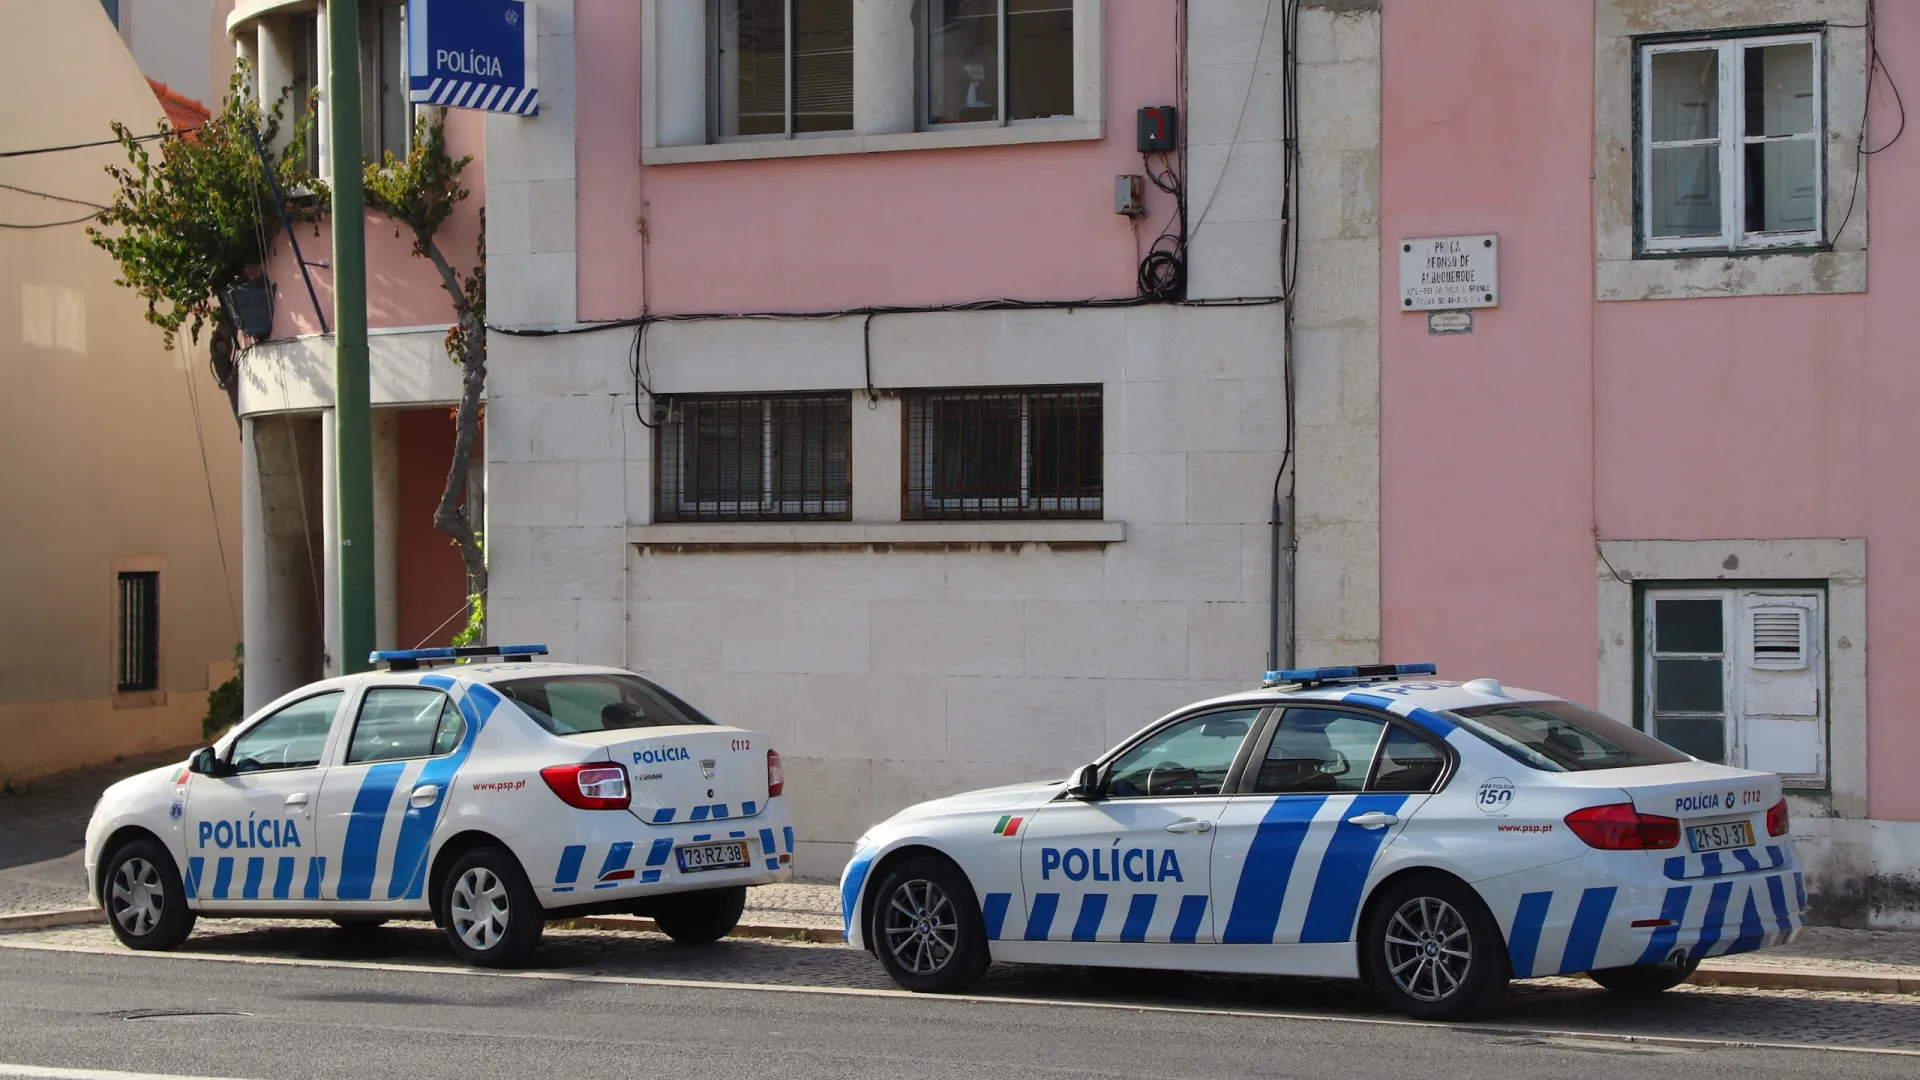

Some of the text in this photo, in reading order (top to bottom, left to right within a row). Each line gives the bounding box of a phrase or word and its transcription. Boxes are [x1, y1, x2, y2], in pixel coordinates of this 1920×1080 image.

[436, 48, 503, 77] POLÍCIA
[1426, 256, 1457, 269] AFONSO
[1421, 270, 1475, 284] ALBUQUERQUE
[735, 740, 750, 750] 112
[633, 745, 690, 764] POLÍCIA
[473, 779, 526, 792] www.psp.pt
[1479, 789, 1512, 804] 150
[1676, 792, 1720, 812] POLÍCIA
[1747, 790, 1761, 804] 112
[199, 811, 301, 849] POLÍCIA
[1497, 824, 1552, 833] www.psp.pt
[1041, 837, 1184, 882] POLÍCIA
